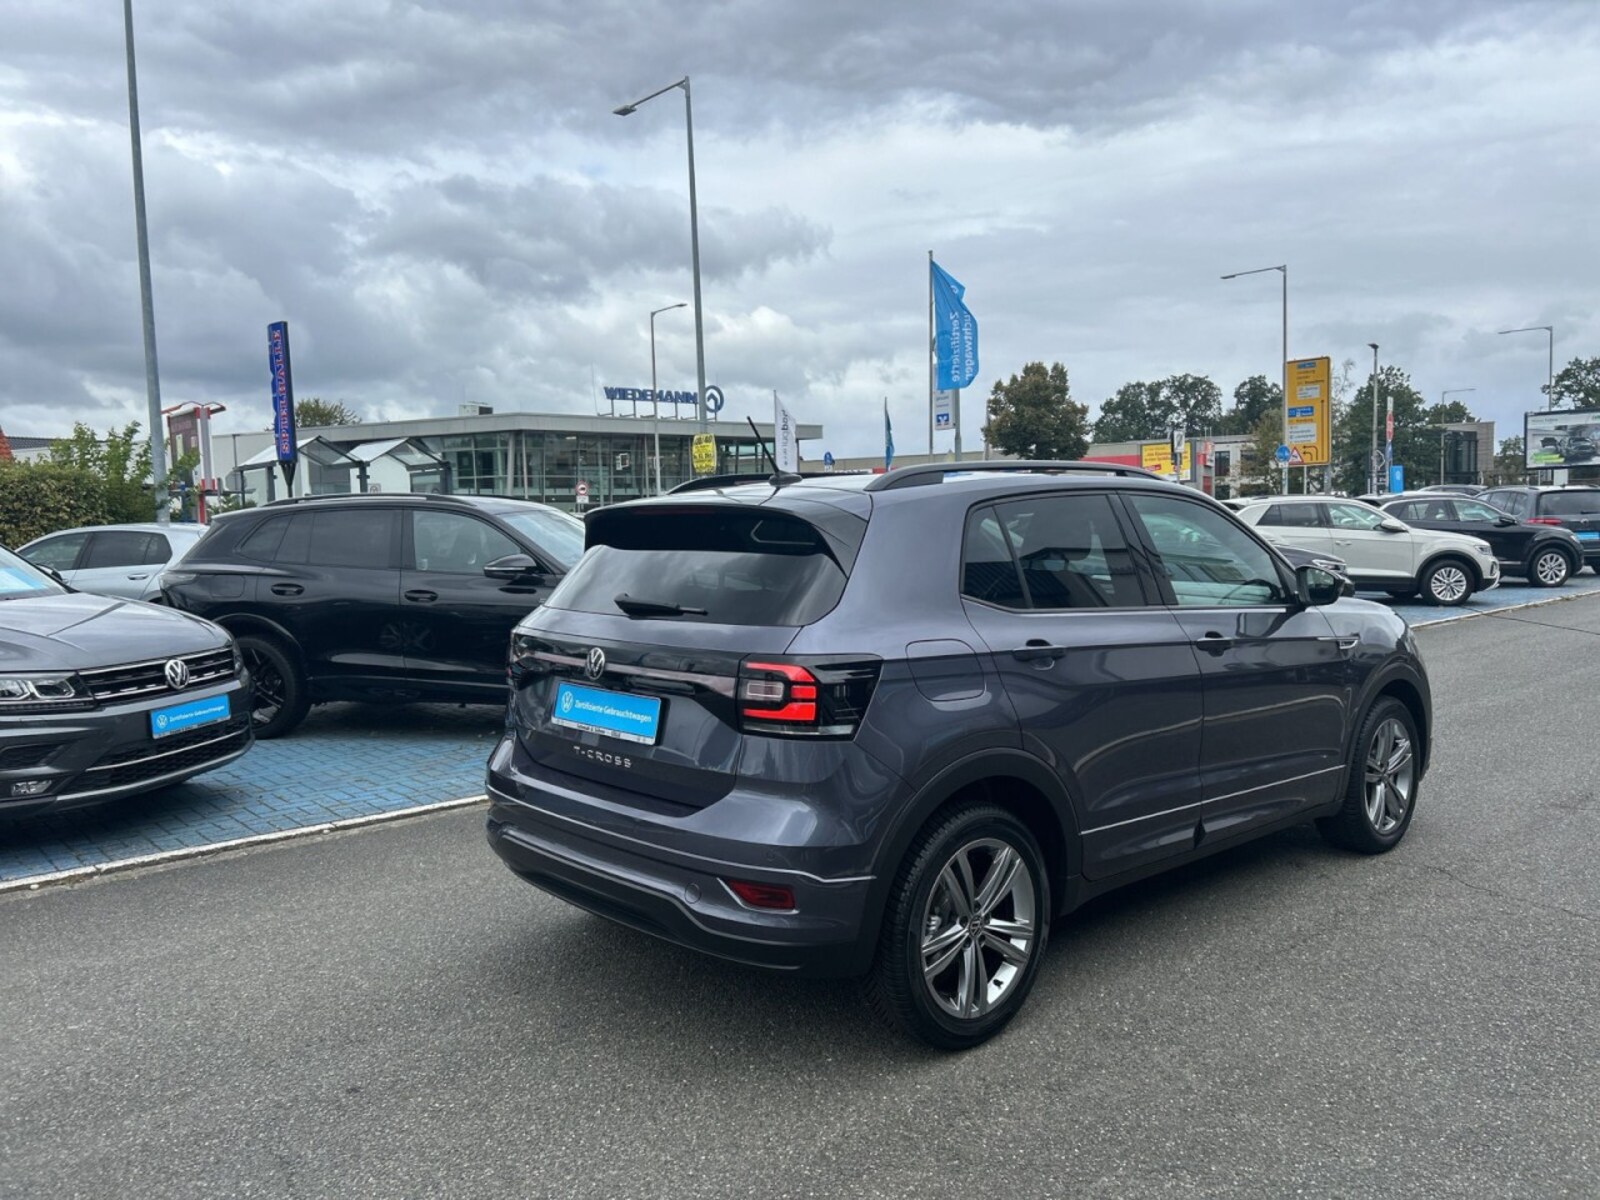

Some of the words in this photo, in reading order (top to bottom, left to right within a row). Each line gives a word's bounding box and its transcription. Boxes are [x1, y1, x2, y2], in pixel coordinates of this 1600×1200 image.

[272, 329, 290, 454] SPIELHALLE
[604, 386, 699, 404] WIEDEMANN
[573, 745, 632, 769] T-CROSS
